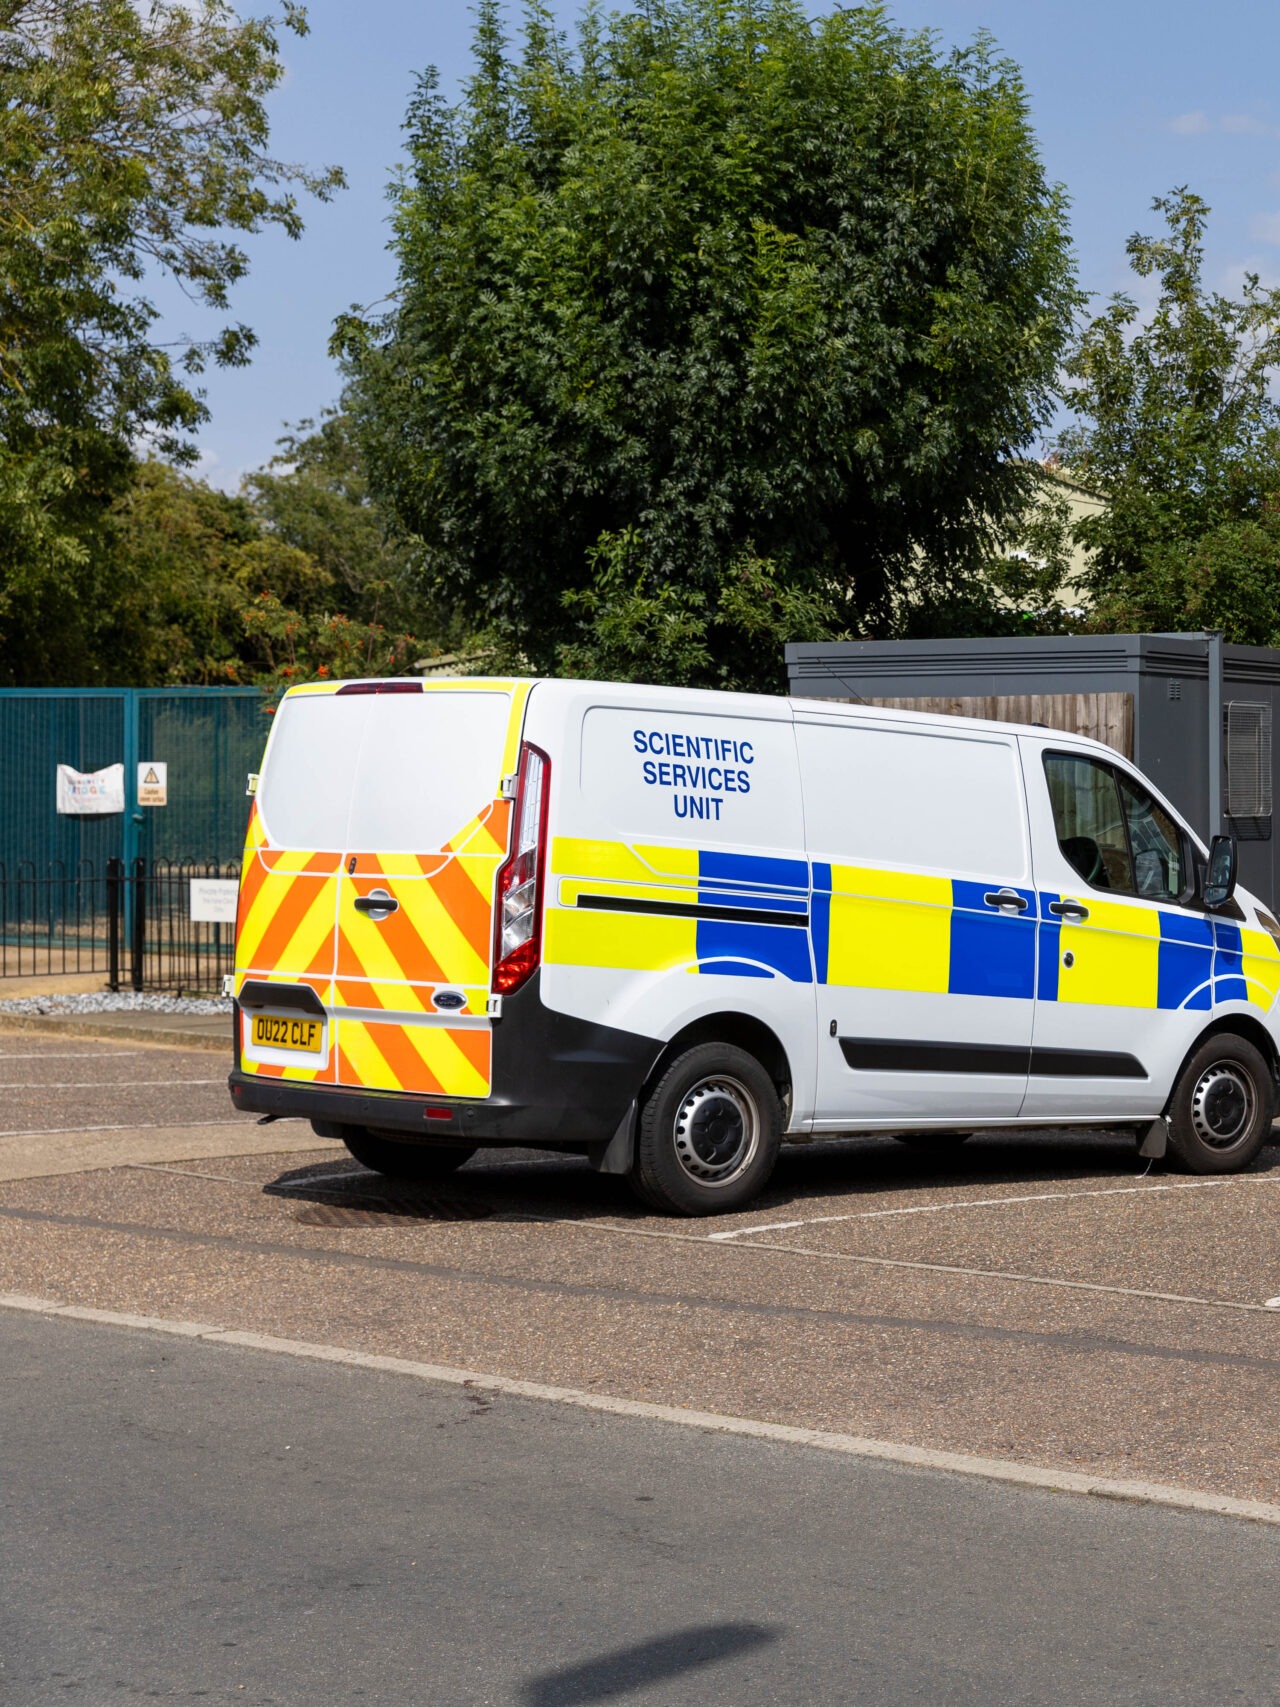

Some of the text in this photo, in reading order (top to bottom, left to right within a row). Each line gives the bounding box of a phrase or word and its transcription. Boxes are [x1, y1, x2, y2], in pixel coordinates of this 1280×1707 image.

[633, 729, 754, 765] SCIENTIFIC
[642, 760, 751, 794] SERVICES
[673, 794, 724, 821] UNIT
[256, 1018, 316, 1047] OU22 CLF
